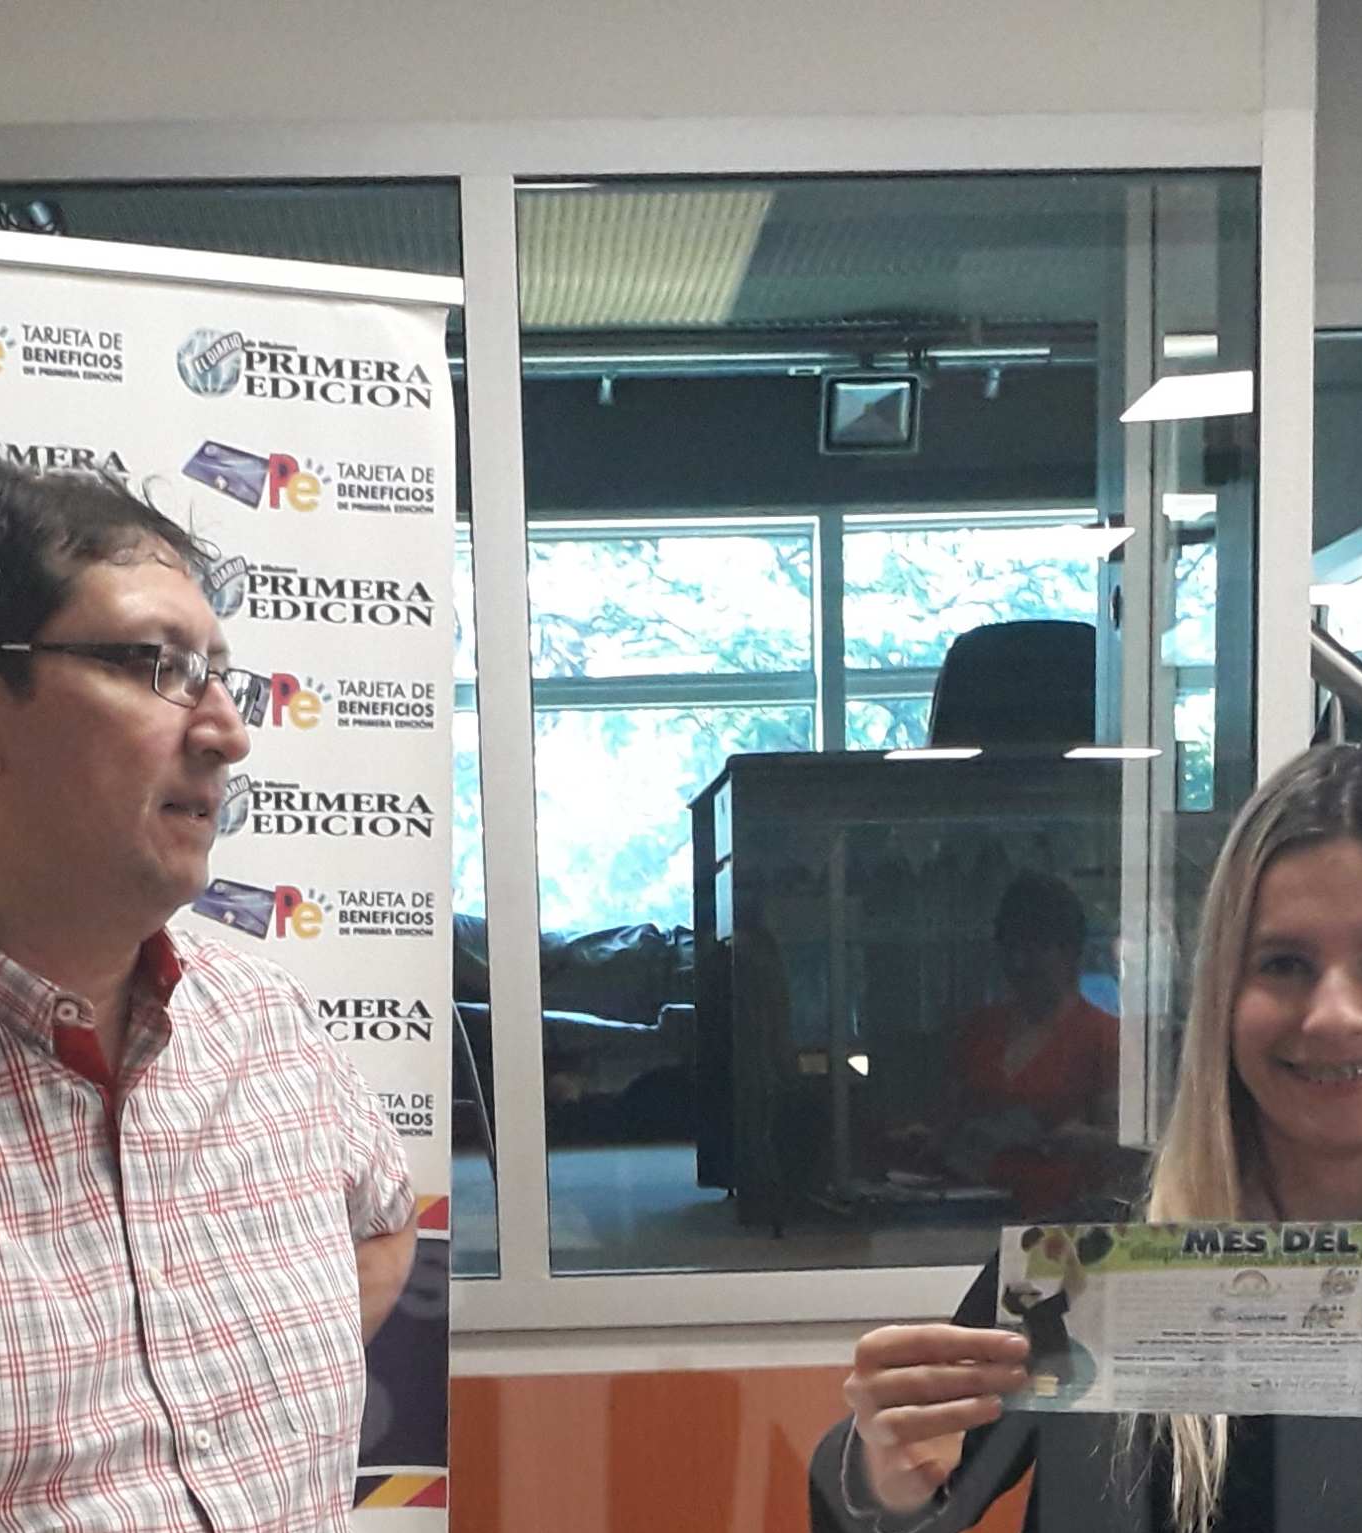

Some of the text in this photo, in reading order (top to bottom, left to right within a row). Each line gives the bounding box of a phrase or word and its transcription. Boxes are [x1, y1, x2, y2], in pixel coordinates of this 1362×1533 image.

[22, 323, 123, 351] TARJETA DE
[22, 346, 123, 371] BENEFICIOS
[195, 356, 210, 375] EL
[208, 333, 243, 365] DIARIO
[23, 366, 36, 377] DE
[244, 350, 432, 386] PRIMERA
[244, 375, 432, 410] EDICION
[268, 452, 321, 513] Pe
[337, 462, 435, 485] TARJETA DE
[337, 483, 435, 502] BENEFICIOS
[337, 501, 349, 511] DE
[211, 556, 246, 590] DIARIO
[246, 573, 434, 603] PRIMERA
[247, 597, 434, 627] EDICION
[271, 671, 323, 731] Pe
[338, 679, 435, 699] TARJETA DE
[338, 700, 435, 718] BENEFICIOS
[338, 718, 350, 727] DE
[225, 774, 250, 799] ARIO
[251, 790, 434, 815] PRIMERA
[252, 813, 433, 839] EDICION
[274, 884, 324, 939] Pe
[339, 890, 435, 909] TARJETA DE
[339, 909, 435, 926] BENEFICIOS
[339, 926, 350, 936] DE
[318, 998, 434, 1020] MERA
[325, 1021, 433, 1042] CION
[411, 1094, 434, 1110] DE
[1182, 1227, 1268, 1255] MES
[1282, 1227, 1359, 1255] DEL
